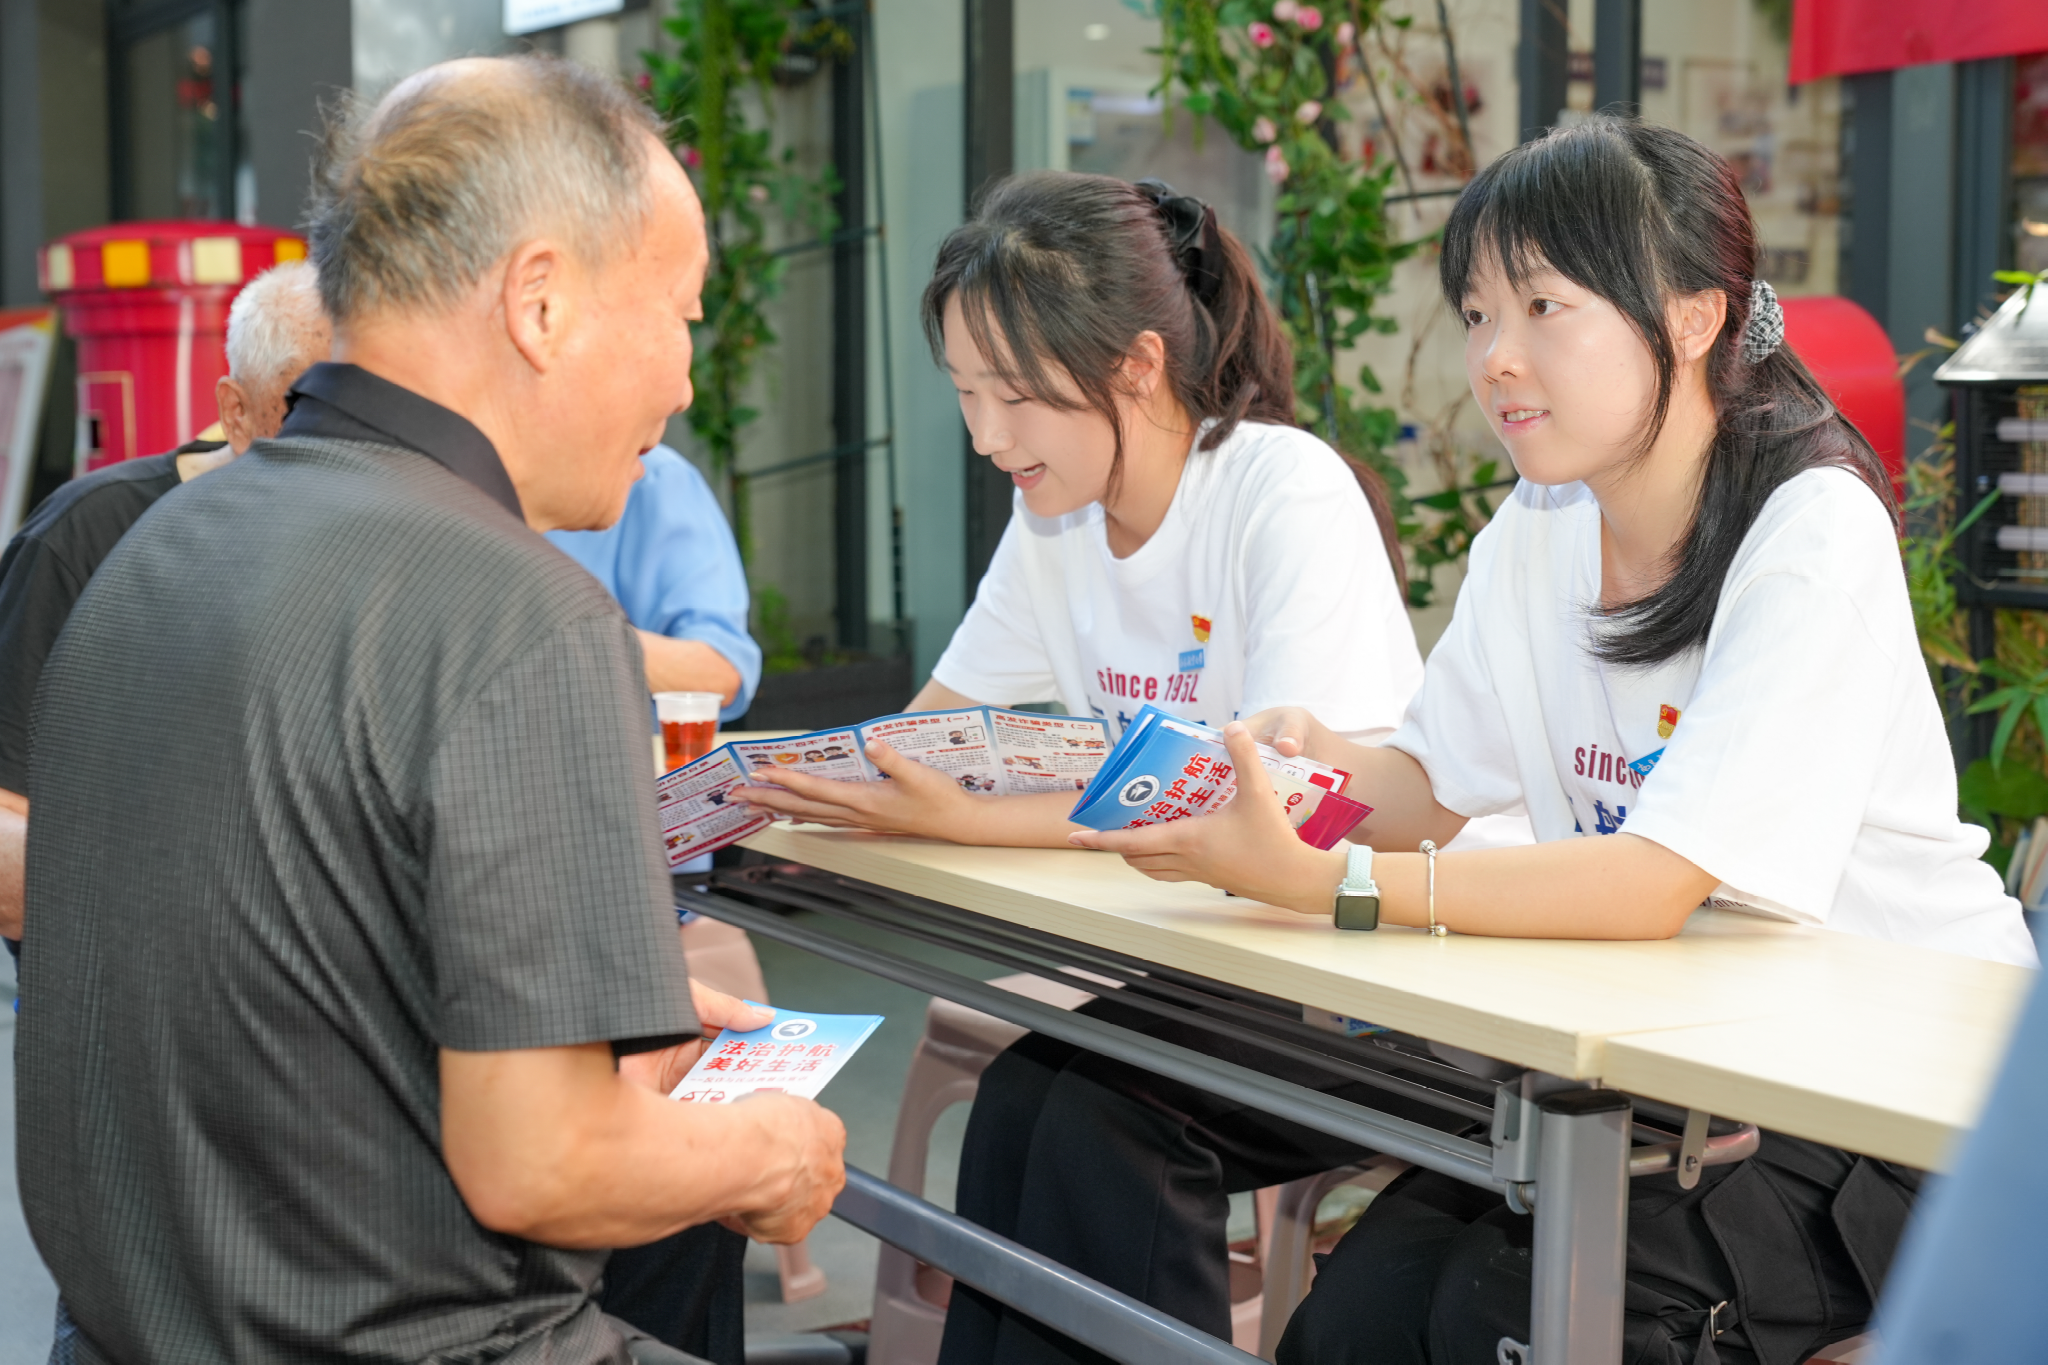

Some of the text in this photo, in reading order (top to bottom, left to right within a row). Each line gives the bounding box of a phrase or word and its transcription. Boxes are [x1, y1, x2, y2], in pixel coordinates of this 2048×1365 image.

[1096, 667, 1158, 701] since
[718, 1039, 840, 1057] 法治护航
[702, 1056, 823, 1073] 美好生活
